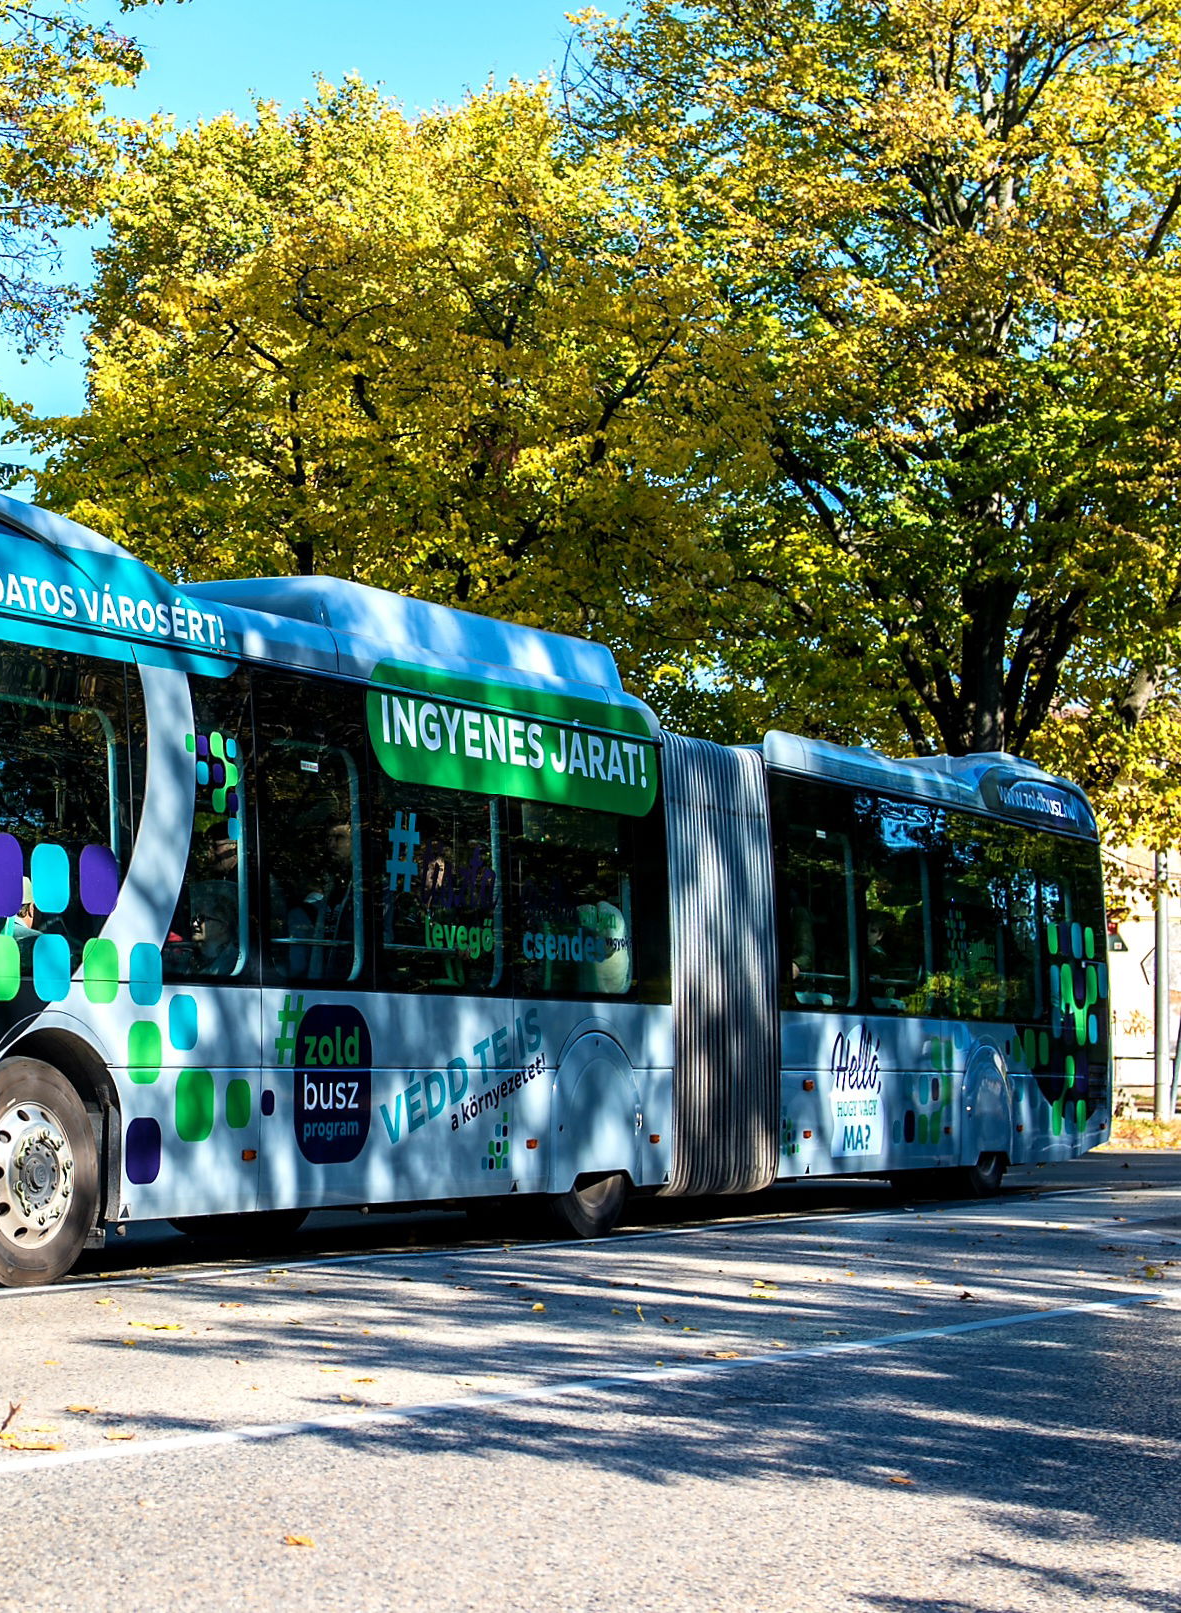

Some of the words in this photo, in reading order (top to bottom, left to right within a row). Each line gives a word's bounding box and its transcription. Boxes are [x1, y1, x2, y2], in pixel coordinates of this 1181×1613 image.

[79, 583, 227, 647] VÁROSÉRT!
[380, 694, 545, 769] INGYENES
[425, 915, 494, 960] levegő
[379, 1056, 469, 1145] VÉDD
[473, 1026, 512, 1085] TE
[515, 1008, 543, 1060] IS
[831, 1023, 881, 1094] Helló,
[303, 1074, 359, 1110] busz
[451, 1113, 459, 1131] a
[461, 1053, 546, 1125] környezetet!
[303, 1120, 359, 1142] program
[843, 1124, 871, 1151] MA?
